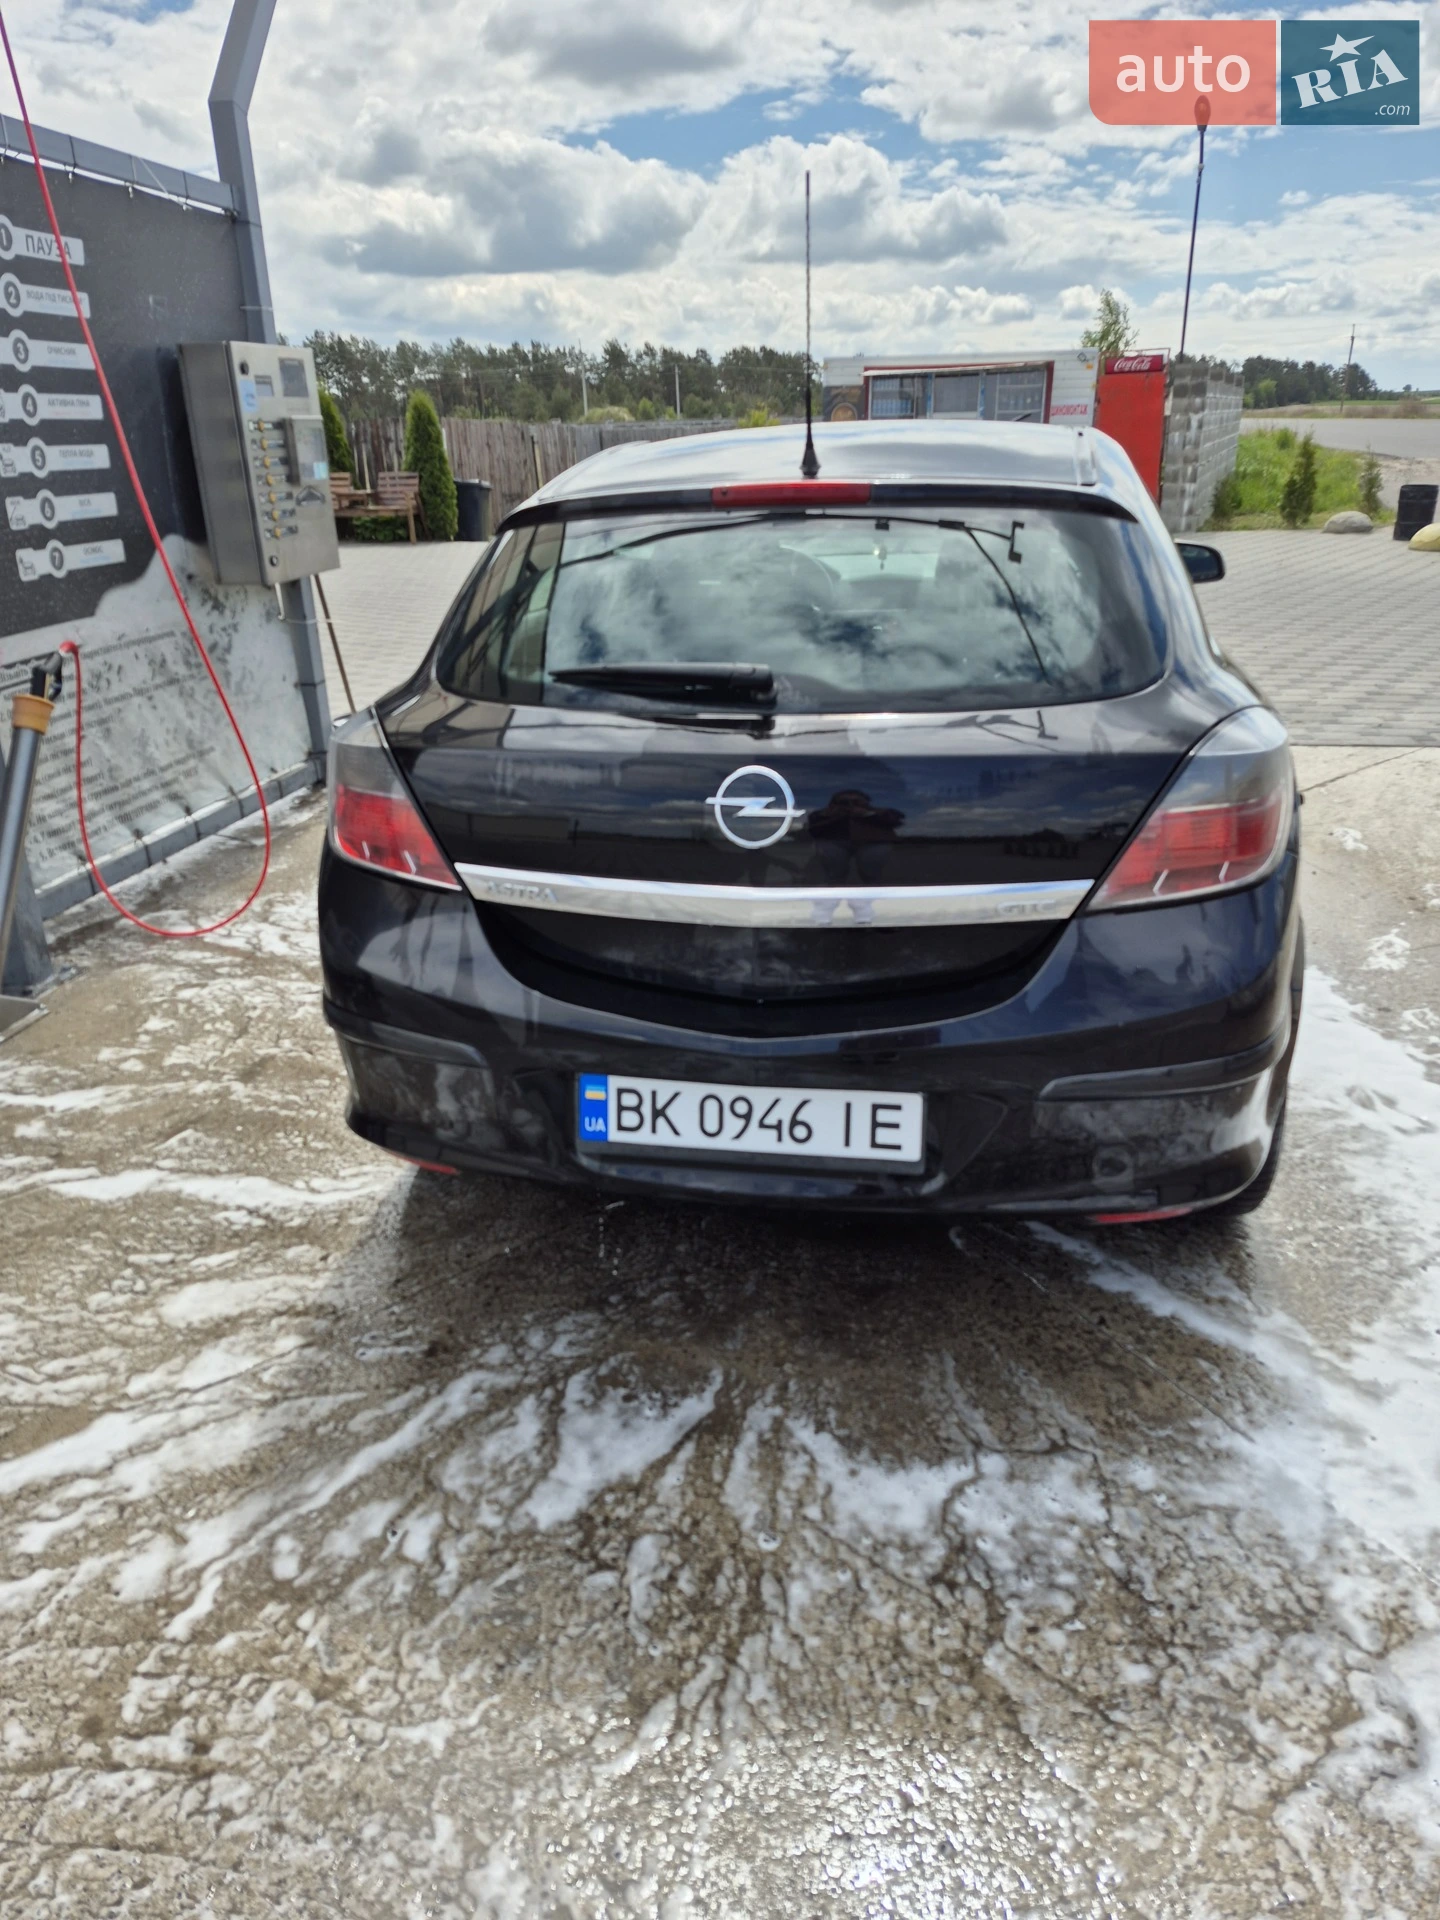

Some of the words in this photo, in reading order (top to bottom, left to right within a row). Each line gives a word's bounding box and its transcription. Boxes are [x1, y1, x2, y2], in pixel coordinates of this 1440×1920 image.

[584, 1115, 606, 1132] UA
[616, 1087, 681, 1138] BK
[699, 1094, 813, 1145] 0946
[844, 1102, 902, 1151] IE
